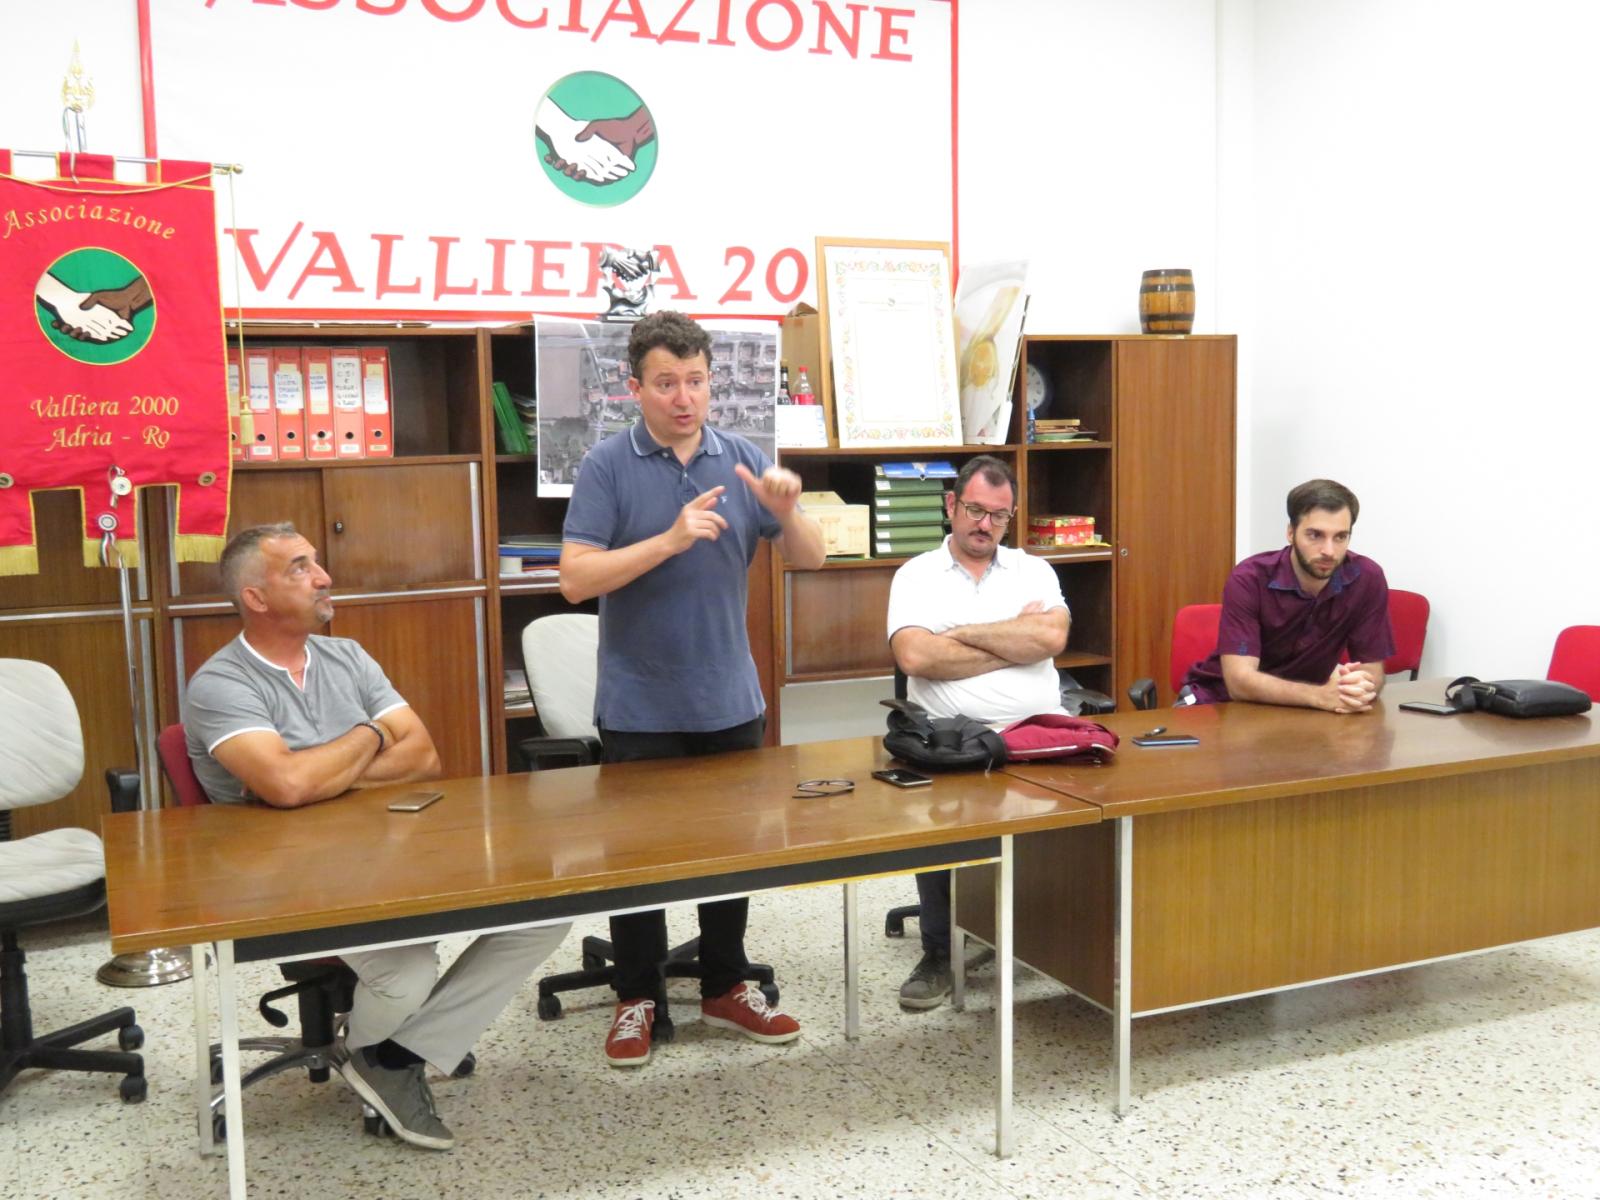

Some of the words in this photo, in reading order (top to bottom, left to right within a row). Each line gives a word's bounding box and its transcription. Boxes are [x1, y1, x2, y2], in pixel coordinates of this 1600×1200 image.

[205, 0, 916, 63] CIAZIONE
[3, 198, 176, 239] Associazione
[31, 395, 119, 419] Valliera
[130, 396, 179, 416] 2000
[45, 425, 112, 451] Adria
[142, 425, 171, 449] Ro
